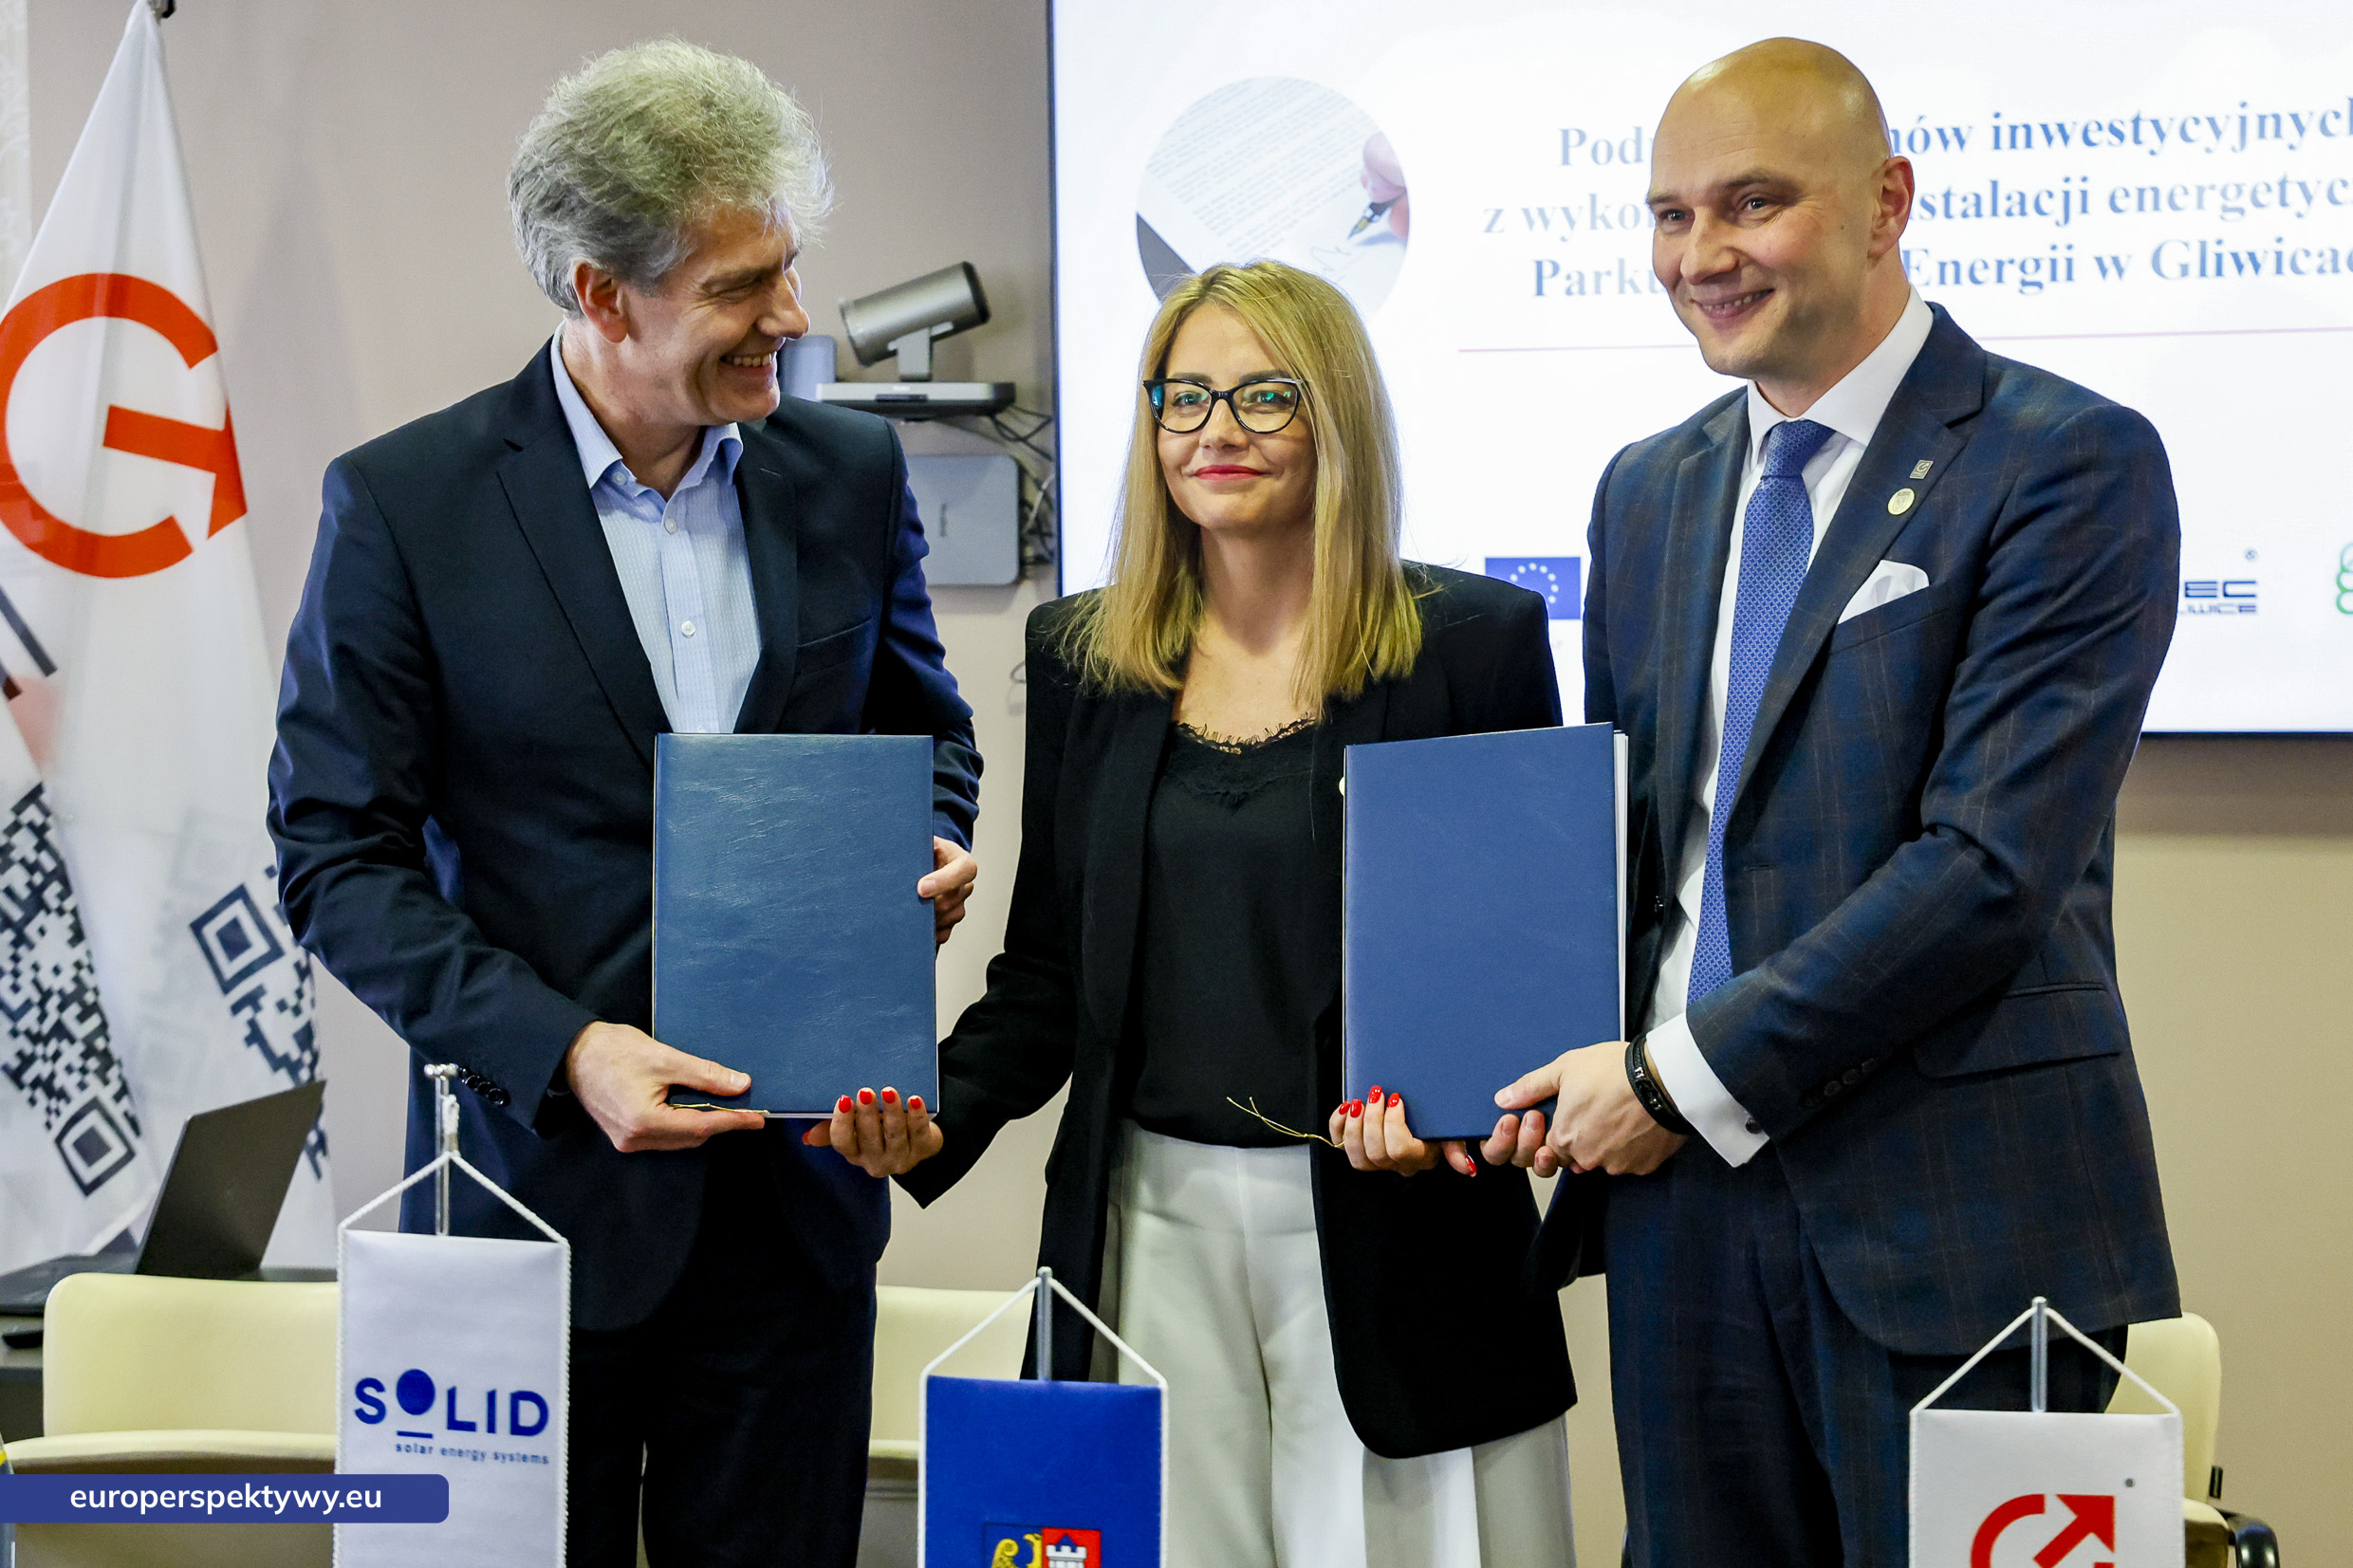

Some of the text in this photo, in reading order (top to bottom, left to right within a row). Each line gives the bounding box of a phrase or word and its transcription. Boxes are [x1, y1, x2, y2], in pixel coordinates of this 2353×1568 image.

[1558, 126, 1652, 167] Pod
[1992, 97, 2353, 156] inwestycyjnyc
[1483, 208, 1505, 233] z
[1909, 175, 2091, 228] stalacji
[2108, 172, 2353, 223] energetyc
[1901, 244, 2075, 296] Energii
[2093, 253, 2132, 281] w
[354, 1369, 549, 1438] SOLID
[396, 1442, 550, 1466] solar energy systems
